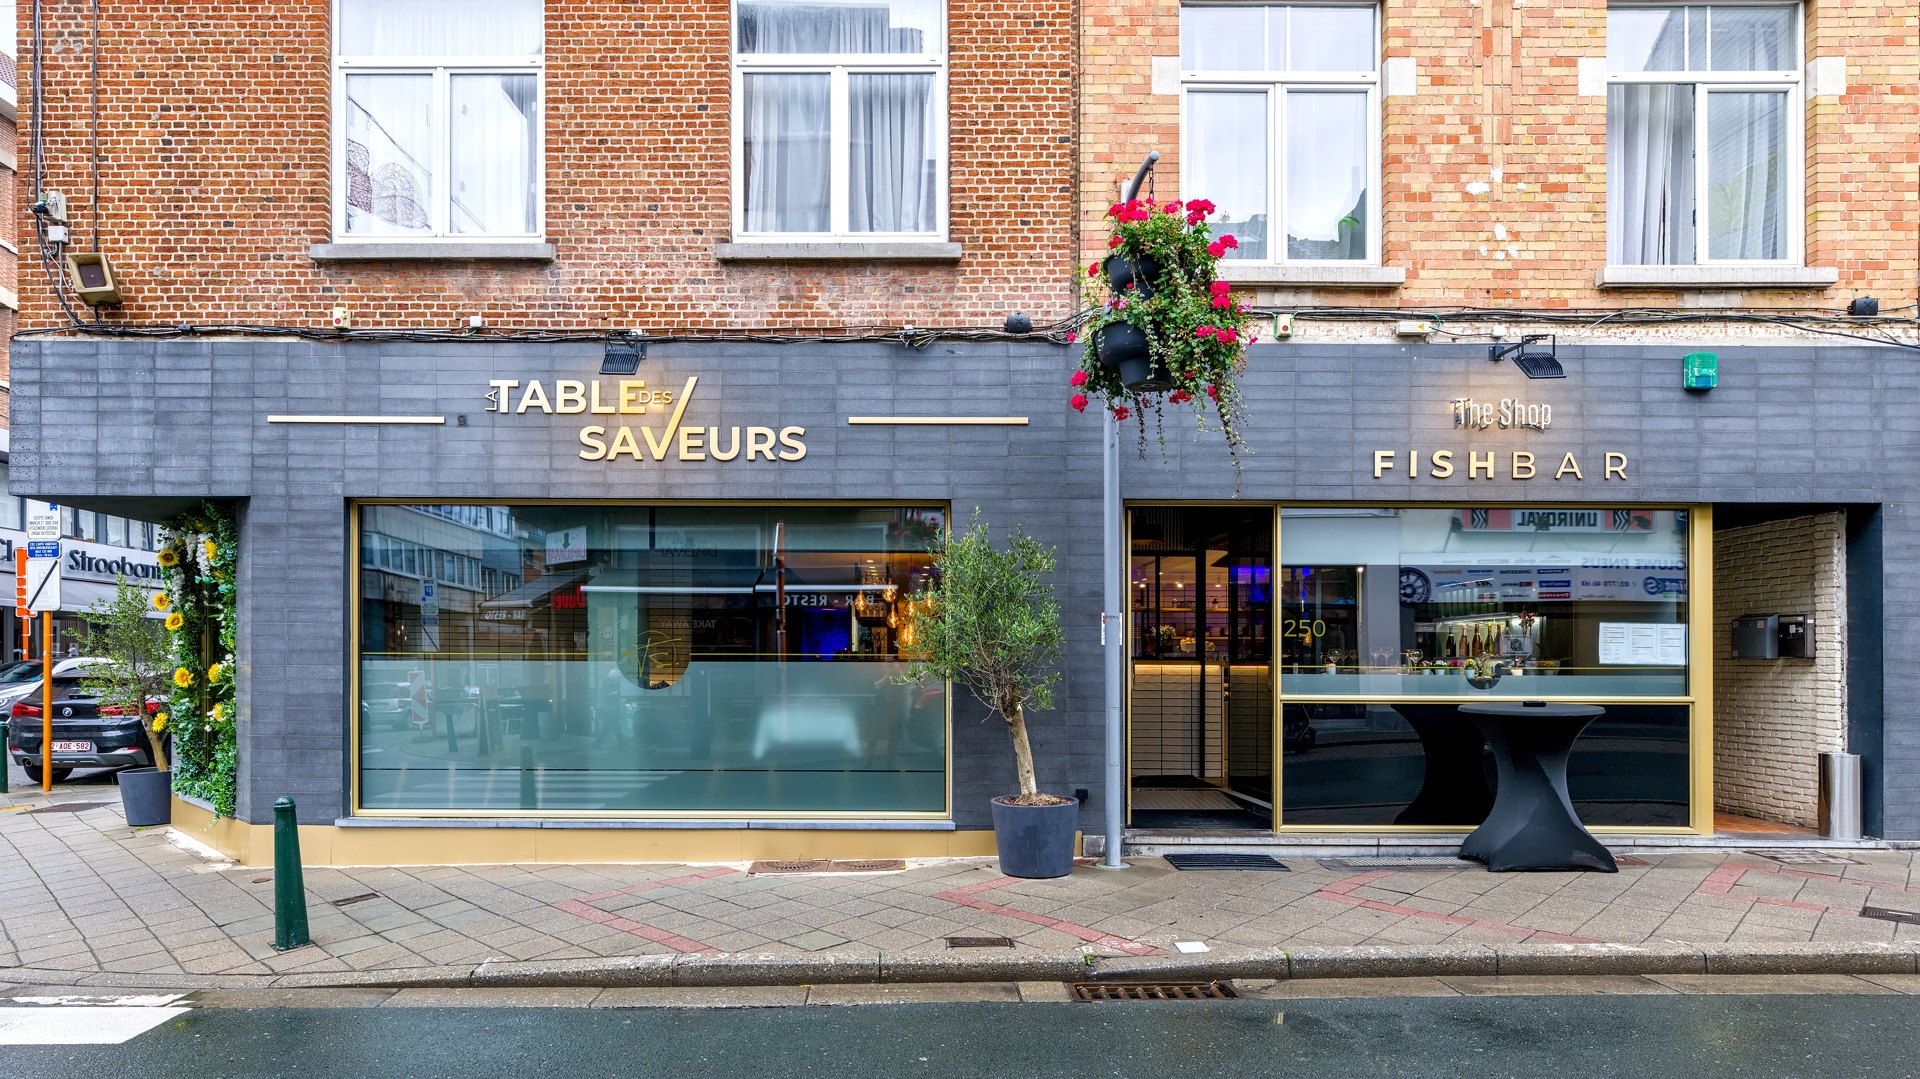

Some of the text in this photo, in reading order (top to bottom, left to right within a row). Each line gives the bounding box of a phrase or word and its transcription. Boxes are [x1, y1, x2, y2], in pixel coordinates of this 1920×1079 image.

[485, 390, 498, 411] LA
[489, 379, 647, 415] TABLE
[638, 390, 673, 404] DES
[578, 376, 808, 462] SAVEURS
[1453, 397, 1552, 430] The Shop
[1283, 619, 1327, 638] 250
